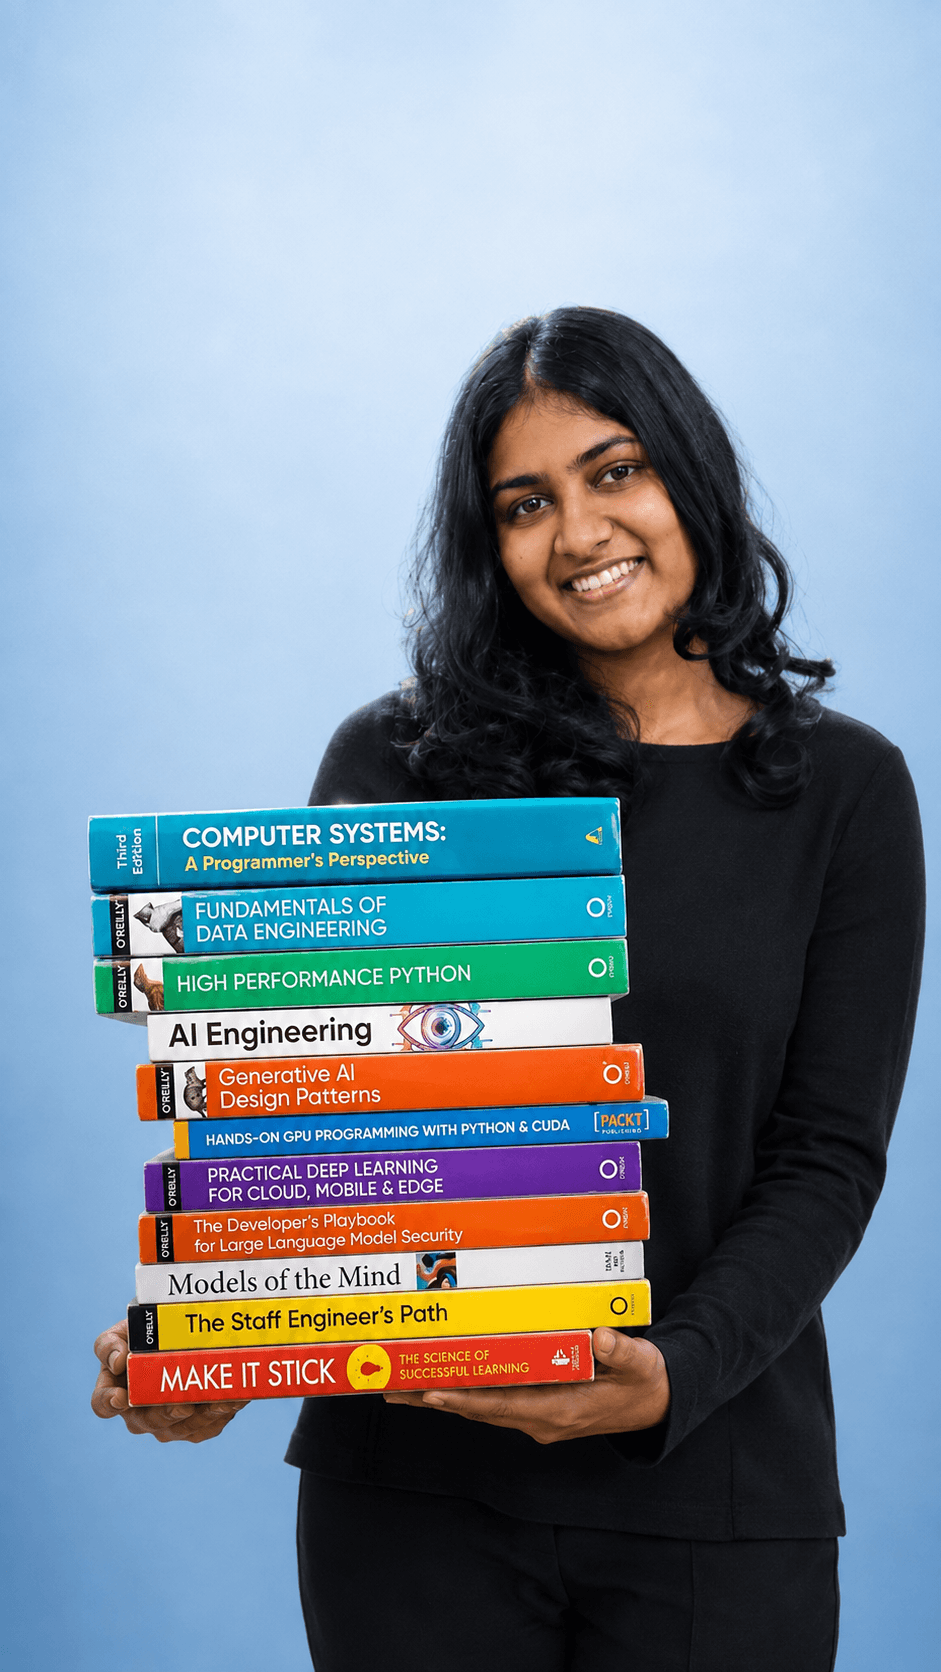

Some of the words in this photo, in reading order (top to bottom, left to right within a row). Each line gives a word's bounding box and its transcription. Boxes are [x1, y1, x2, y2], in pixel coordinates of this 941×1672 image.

[183, 825, 321, 848] COMPUTER
[330, 821, 445, 844] SYSTEMS:
[116, 835, 127, 869] Third
[185, 856, 198, 871] A
[329, 850, 429, 869] Perspective
[196, 897, 352, 920] FUNDAMENTALS
[359, 896, 386, 913] OF
[197, 924, 247, 942] DATA
[255, 919, 386, 939] ENGINEERING
[178, 974, 226, 992] HIGH
[234, 968, 383, 990] PERFORMANCE
[390, 965, 470, 984] PYTHON
[169, 1023, 196, 1047] AI
[207, 1017, 371, 1051] Engineering
[219, 1065, 330, 1085] Generative
[337, 1064, 354, 1081] AI
[221, 1089, 289, 1111] Design
[297, 1088, 380, 1104] Patterns
[207, 1132, 279, 1145] HANDS-ON
[284, 1130, 311, 1142] GPU
[316, 1126, 419, 1140] PROGRAMMING
[423, 1124, 457, 1136] WITH
[462, 1122, 515, 1134] PYTHON
[519, 1121, 528, 1132] &
[532, 1119, 570, 1131] CUDA
[601, 1113, 642, 1127] PACKT
[208, 1165, 302, 1182] PRACTICAL
[307, 1163, 348, 1178] DEEP
[355, 1159, 438, 1176] LEARNING
[209, 1187, 242, 1202] FOR
[248, 1185, 310, 1200] CLOUD,
[316, 1182, 377, 1197] MOBILE
[382, 1181, 393, 1195] &
[399, 1178, 443, 1194] EDGE
[194, 1220, 222, 1233] The
[324, 1212, 395, 1231] Playbook
[195, 1239, 215, 1252] for
[220, 1239, 263, 1254] Large
[268, 1236, 345, 1252] Language
[351, 1230, 396, 1245] Model
[401, 1228, 463, 1244] Security
[169, 1270, 257, 1295] Models
[265, 1268, 290, 1291] of
[295, 1268, 330, 1289] the
[339, 1263, 401, 1287] Mind
[185, 1314, 224, 1332] The
[232, 1310, 281, 1330] Staff
[401, 1303, 447, 1323] Path
[399, 1354, 419, 1364] THE
[424, 1351, 470, 1363] SCIENCE
[475, 1350, 489, 1360] OF
[161, 1364, 232, 1392] MAKE
[242, 1362, 260, 1387] IT
[269, 1359, 336, 1386] STICK
[400, 1366, 469, 1379] SUCCESSFUL
[474, 1363, 529, 1375] LEARNING
